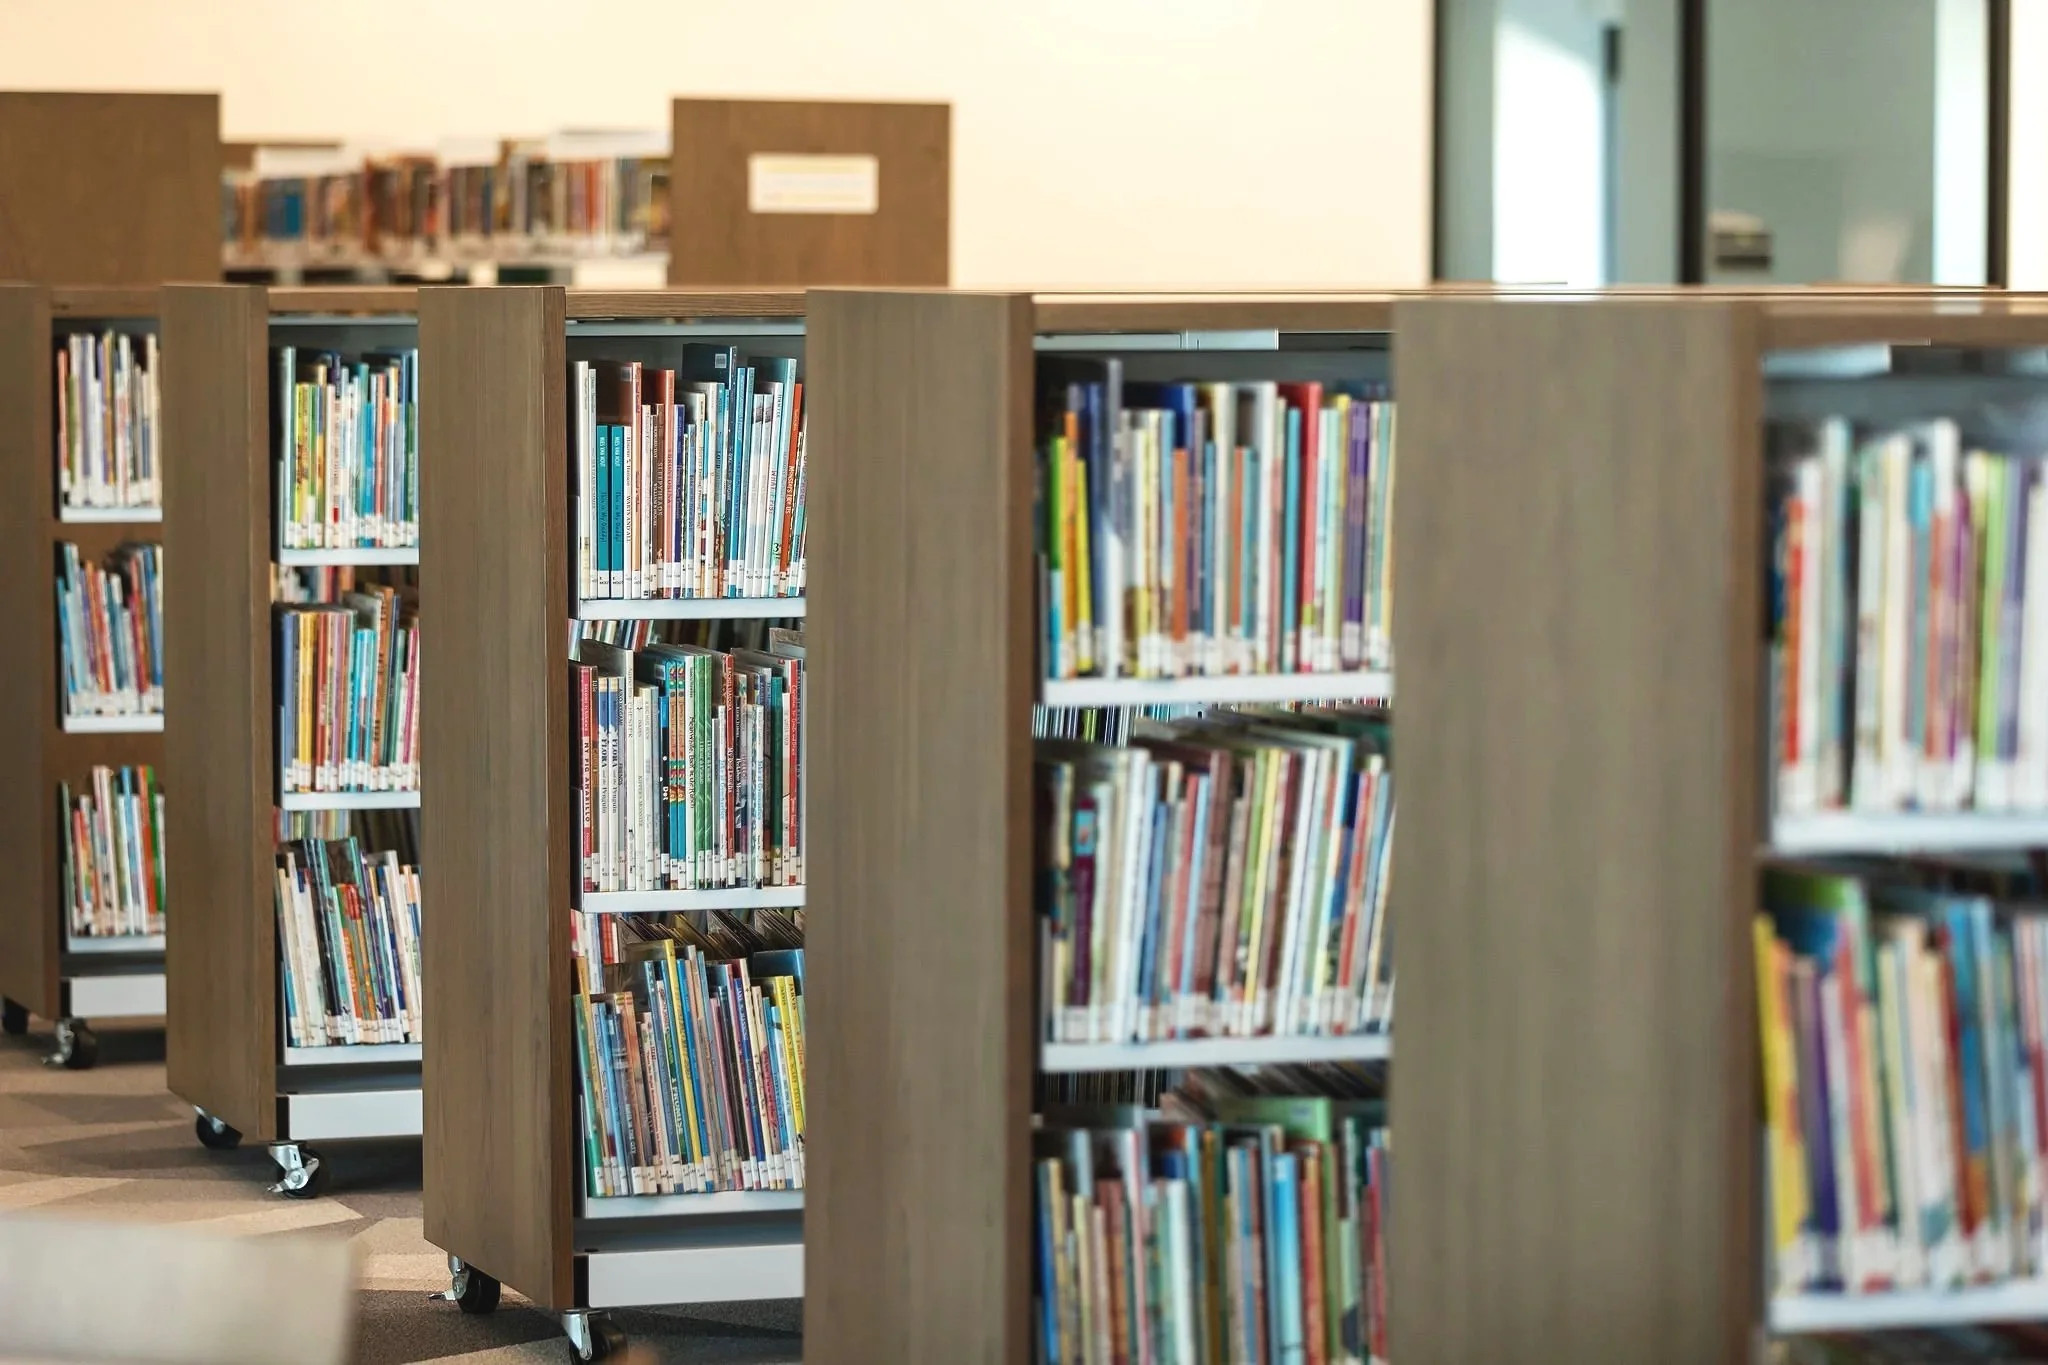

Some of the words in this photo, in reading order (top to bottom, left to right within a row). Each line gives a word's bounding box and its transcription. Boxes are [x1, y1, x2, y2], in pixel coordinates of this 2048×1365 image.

[600, 512, 606, 522] My
[616, 512, 622, 522] My
[584, 742, 589, 754] MY
[672, 1087, 683, 1136] PROMISE
